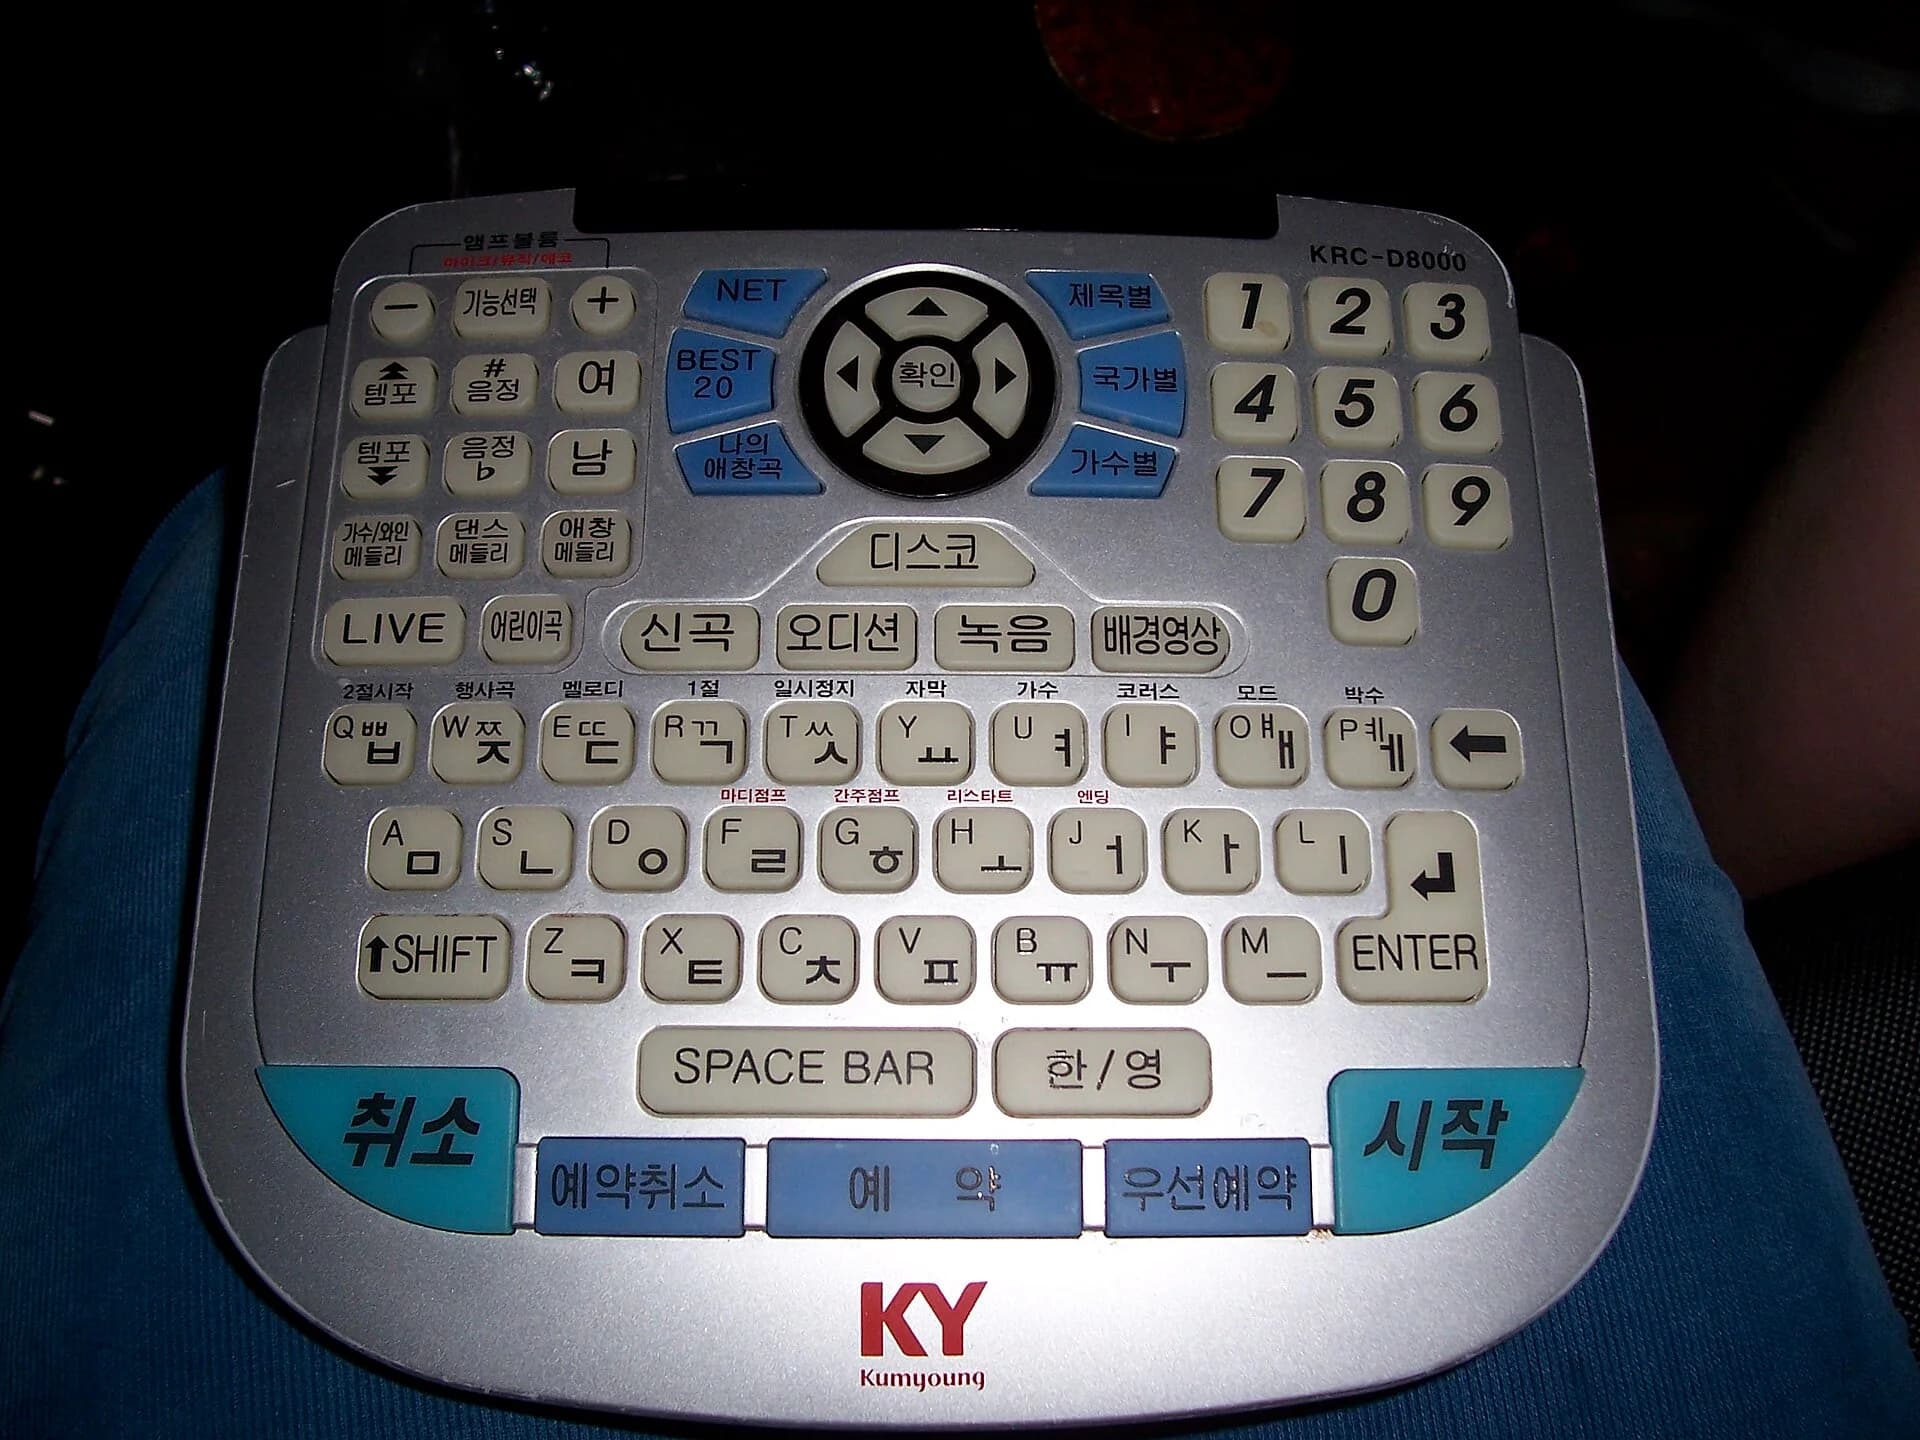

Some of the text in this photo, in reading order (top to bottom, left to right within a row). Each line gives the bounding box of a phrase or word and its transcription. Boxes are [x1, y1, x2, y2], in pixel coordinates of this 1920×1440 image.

[464, 231, 558, 251] 앰프볼륨
[1309, 244, 1468, 273] KRC-D8000
[463, 287, 537, 317] 기능선택
[716, 278, 787, 302] NET
[1068, 281, 1153, 310] 제목별
[1240, 283, 1263, 330] 1
[1329, 286, 1372, 335] 2
[1430, 292, 1467, 341] 3
[676, 348, 762, 372] BEST
[578, 359, 615, 396] 여
[694, 375, 733, 400] 20
[899, 361, 957, 389] 확인
[1092, 365, 1178, 394] 국가별
[364, 383, 417, 406] 템포
[466, 378, 520, 401] 음정
[1233, 374, 1278, 423] 4
[1333, 378, 1376, 428] 5
[1439, 383, 1479, 432] 6
[358, 440, 411, 464] 템포
[461, 436, 515, 459] 음정
[571, 438, 613, 476] 남
[718, 433, 769, 457] 나의
[703, 457, 784, 481] 애창곡
[1070, 448, 1160, 478] 가수별
[1242, 468, 1286, 518] 7
[1346, 470, 1387, 523] 8
[1450, 475, 1492, 526] 9
[342, 521, 409, 544] 가수/와인
[454, 518, 509, 540] 댄스
[559, 517, 616, 539] 애창
[344, 546, 402, 567] 메들리
[450, 542, 508, 564] 메들리
[554, 541, 614, 562] 메들리
[870, 532, 980, 572] 디스코
[1350, 568, 1397, 622] 0
[342, 612, 446, 644] LIVE
[491, 609, 563, 642] 어린이곡
[641, 611, 735, 652] 신곡
[786, 613, 900, 654] 오디션
[956, 613, 1053, 654] 녹음
[1104, 615, 1222, 657] 배경영상
[343, 681, 414, 701] 2절시작
[454, 679, 517, 700] 행사곡
[561, 678, 624, 699] 멜로디
[686, 678, 720, 698] 1절
[772, 678, 855, 699] 일시정지
[906, 679, 947, 698] 자막
[1017, 679, 1059, 699] 가수
[1116, 681, 1180, 700] 코러스
[1236, 684, 1279, 702] 모드
[1344, 685, 1386, 703] 박수
[333, 715, 354, 740] Q
[441, 715, 471, 738] W
[553, 715, 572, 738] E
[664, 715, 684, 738] R
[779, 715, 798, 738] T
[898, 715, 917, 738] Y
[1013, 715, 1033, 740] U
[1339, 718, 1358, 741] P
[720, 788, 787, 803] 마디점프
[833, 788, 900, 803] 간주점프
[946, 788, 1014, 804] 리스타트
[1077, 789, 1110, 805] 엔딩
[381, 820, 405, 846] A
[492, 819, 513, 845] S
[608, 819, 629, 845] D
[721, 819, 741, 845] F
[835, 818, 859, 845] G
[950, 819, 974, 845] H
[1069, 821, 1083, 845] J
[1184, 819, 1203, 844] K
[1300, 821, 1315, 845] L
[406, 850, 440, 875] ㅁ
[750, 848, 786, 873] ㄹ
[869, 846, 904, 874] ㅎ
[545, 927, 563, 955] Z
[661, 927, 683, 955] X
[779, 926, 803, 955] C
[898, 927, 921, 954] V
[1016, 927, 1038, 955] B
[1126, 928, 1148, 955] N
[1242, 927, 1268, 954] M
[1353, 934, 1478, 973] ENTER
[392, 934, 498, 974] SHIFT
[570, 958, 605, 984] ㅋ
[688, 959, 723, 984] ㅌ
[805, 955, 841, 984] ㅊ
[924, 959, 958, 984] ㅍ
[674, 1048, 933, 1085] SPACE BAR
[1047, 1049, 1162, 1091] 한/영
[342, 1092, 481, 1168] 취소
[1363, 1098, 1510, 1172] 시작
[551, 1163, 725, 1211] 예약취소
[1123, 1164, 1297, 1212] 우선예약
[860, 1281, 988, 1357] KY
[860, 1369, 985, 1391] Kumyoung
